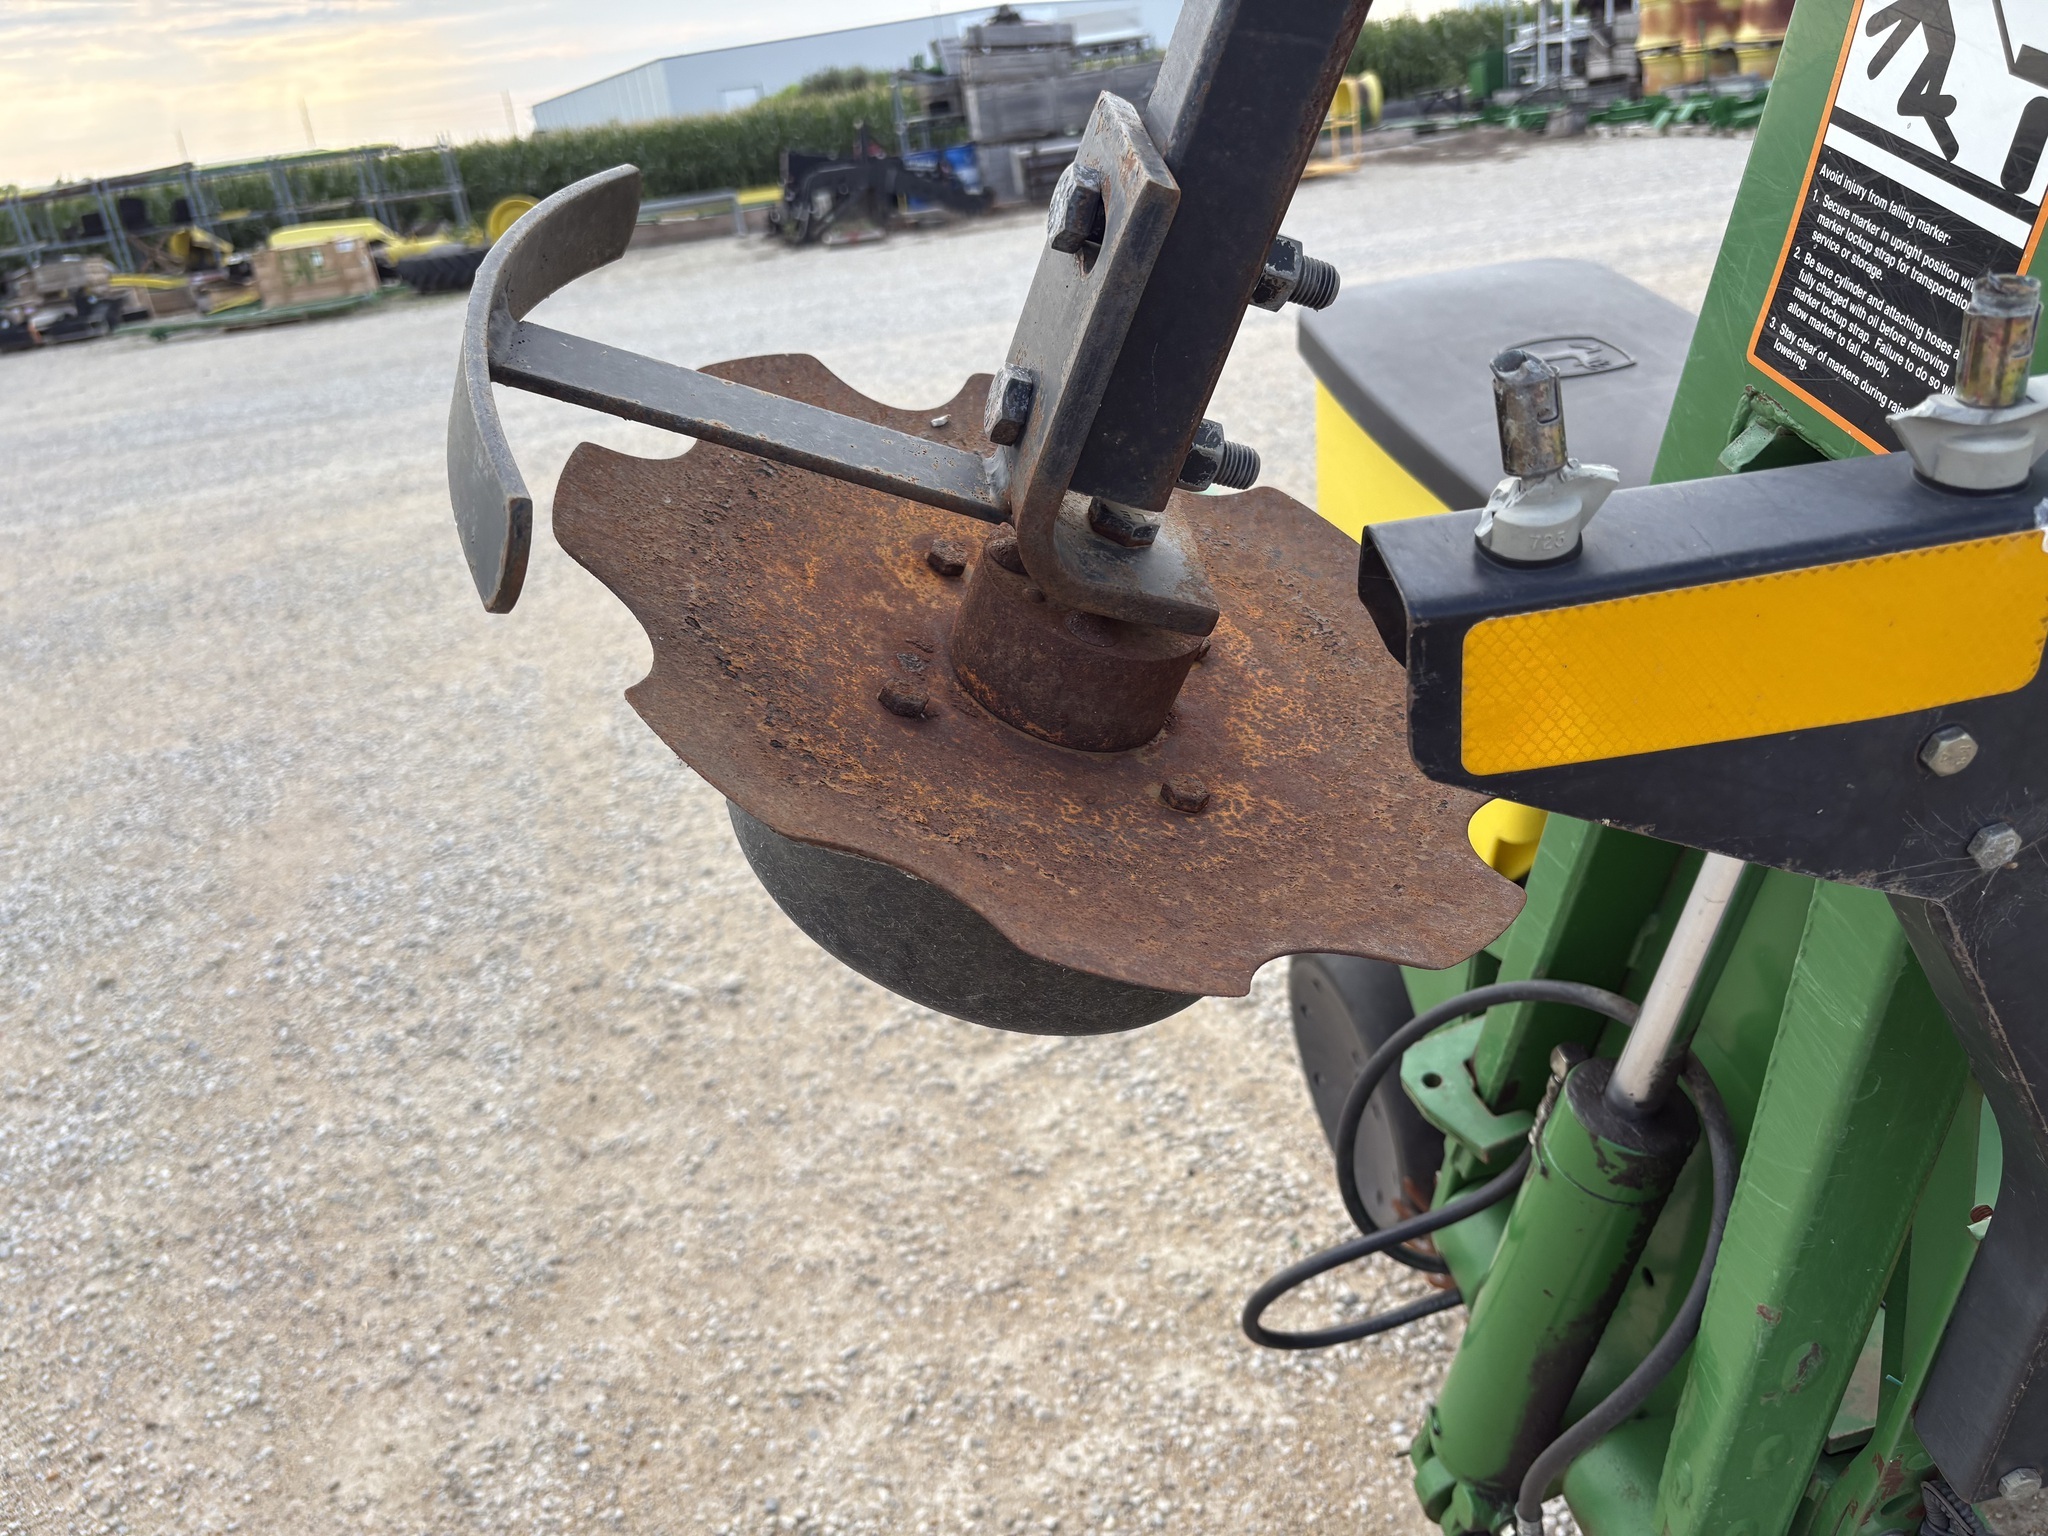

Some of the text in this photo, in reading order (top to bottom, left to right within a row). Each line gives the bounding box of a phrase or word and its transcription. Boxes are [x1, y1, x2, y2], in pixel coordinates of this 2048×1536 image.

[1812, 188, 1975, 293] 1. Secure marker in upright position wit
[1818, 163, 1952, 246] Avoid injury from falling marker:
[1793, 246, 1801, 260] 2.
[1803, 251, 1816, 269] Be
[1815, 261, 1834, 280] sure
[1833, 273, 1868, 300] cylinder
[1866, 294, 1885, 312] and
[1883, 304, 1925, 340] attaching
[1924, 327, 1953, 355] hoses
[1811, 230, 1883, 281] service or storage.
[1816, 213, 1971, 311] marker lockup strap for transportatio
[1769, 316, 1777, 330] 3.
[1779, 322, 1798, 345] Stay
[1796, 337, 1821, 356] clear
[1816, 350, 1828, 363] of
[1826, 357, 1860, 386] markers
[1859, 379, 1888, 408] during
[1773, 337, 1808, 371] lowering.
[1787, 302, 1890, 378] allow marker to fall rapidly.
[1792, 286, 1821, 310] marker
[1819, 301, 1848, 330] lockup
[1847, 322, 1871, 345] strap.
[1874, 336, 1904, 366] Failure
[1904, 357, 1915, 373] to
[1914, 365, 1928, 382] do
[1927, 375, 1941, 390] so
[1798, 268, 1817, 291] fully
[1815, 281, 1850, 309] charged
[1848, 302, 1867, 321] with
[1867, 314, 1880, 329] oil
[1878, 319, 1907, 347] before
[1906, 340, 1950, 378] removing
